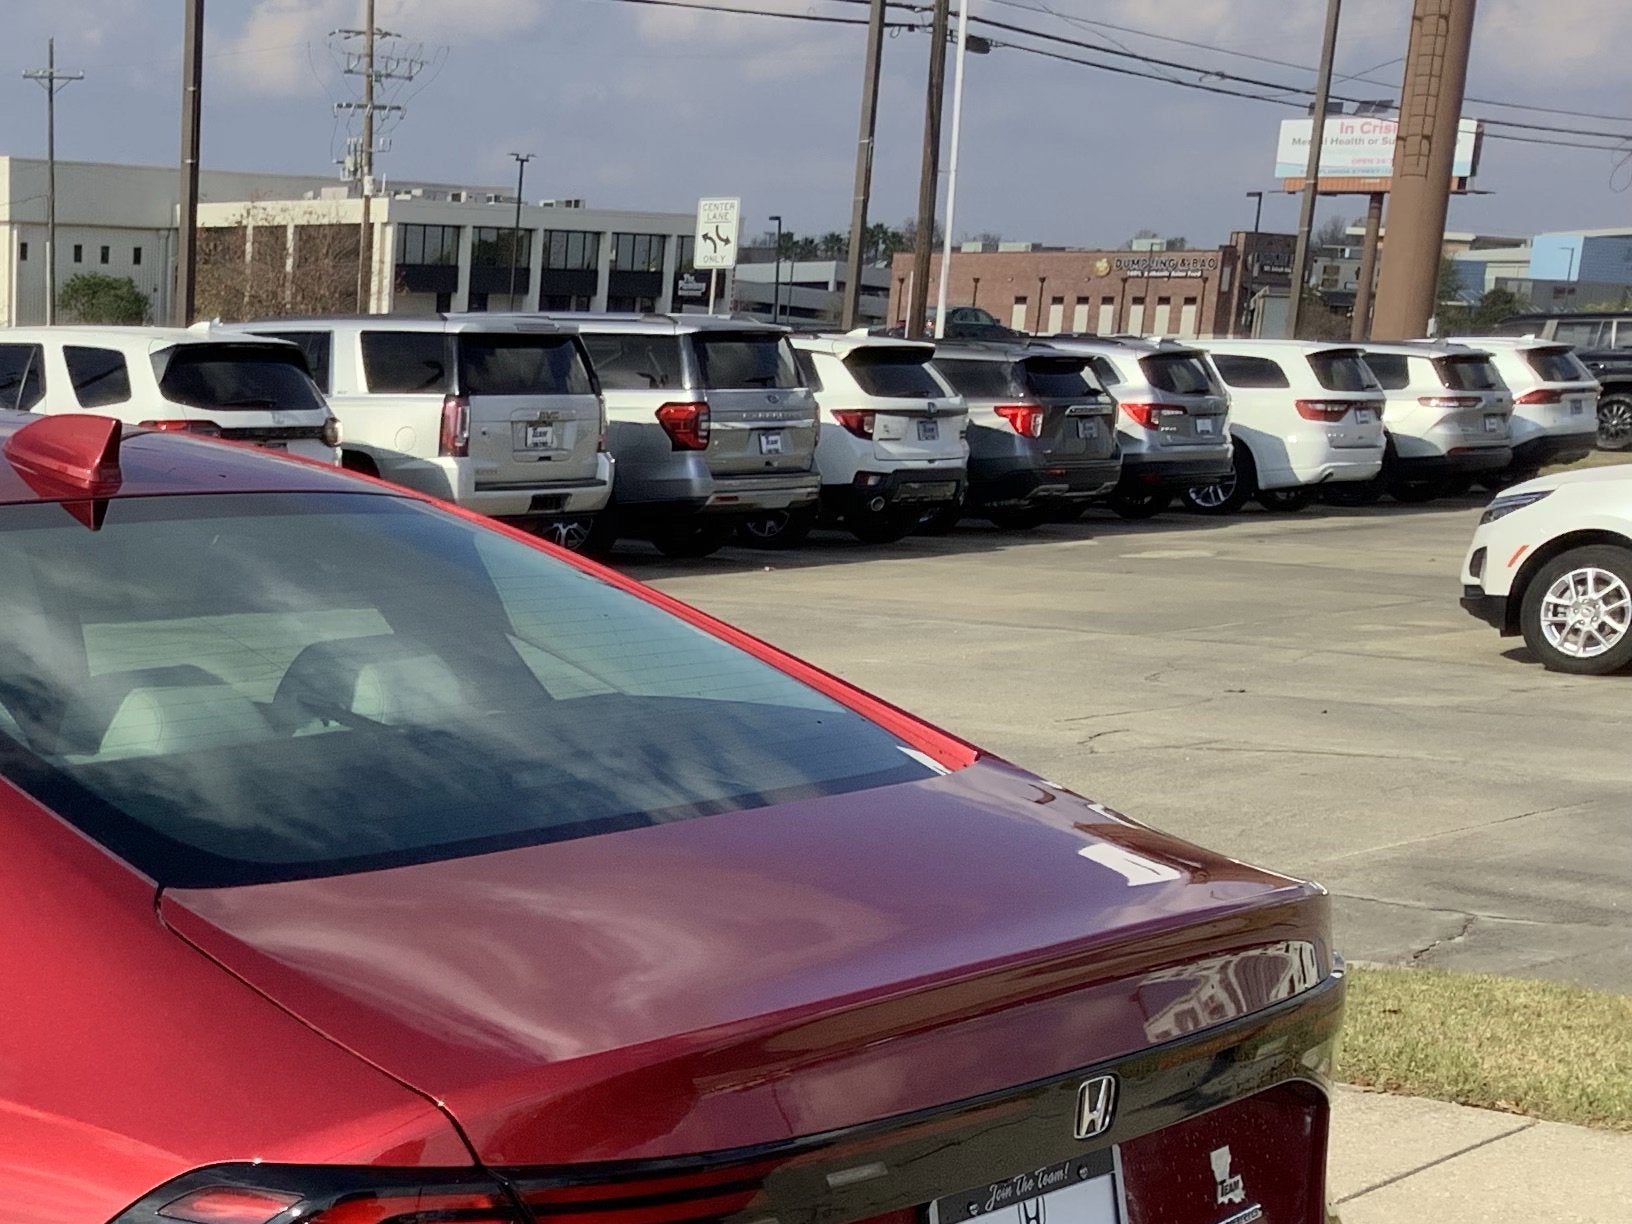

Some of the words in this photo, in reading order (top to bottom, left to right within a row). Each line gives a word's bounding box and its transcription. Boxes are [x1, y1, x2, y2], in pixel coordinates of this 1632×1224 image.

[1339, 121, 1355, 134] In
[1359, 121, 1399, 134] Crisi
[1330, 137, 1366, 146] Health
[1367, 138, 1379, 146] or
[703, 203, 735, 212] CENTER
[707, 212, 729, 220] LANE
[703, 255, 726, 264] ONLY
[1192, 258, 1216, 270] BAO
[984, 1184, 1013, 1211] Join
[1013, 1174, 1034, 1197] The
[1035, 1162, 1071, 1190] Team!
[1218, 1179, 1241, 1198] TEAM
